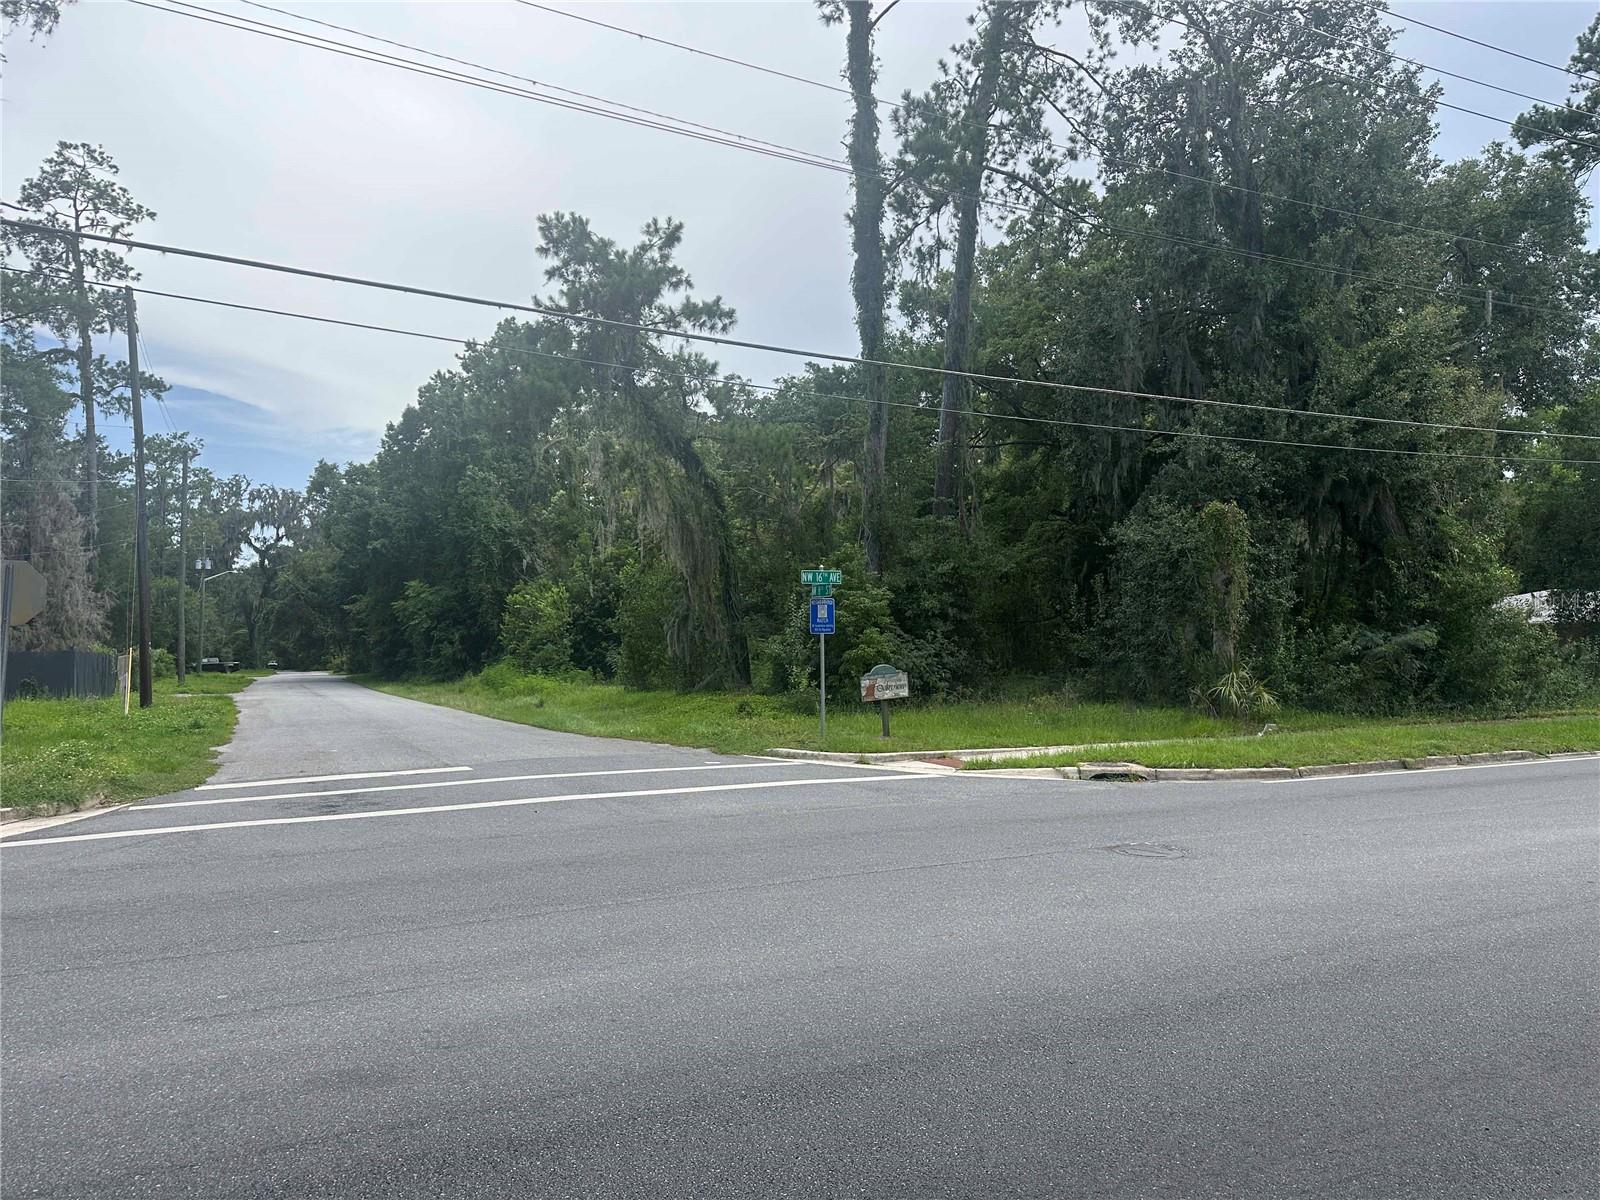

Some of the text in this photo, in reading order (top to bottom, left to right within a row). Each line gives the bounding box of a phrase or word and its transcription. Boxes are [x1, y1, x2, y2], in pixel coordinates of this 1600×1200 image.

[802, 572, 840, 582] NW 16TH AVE
